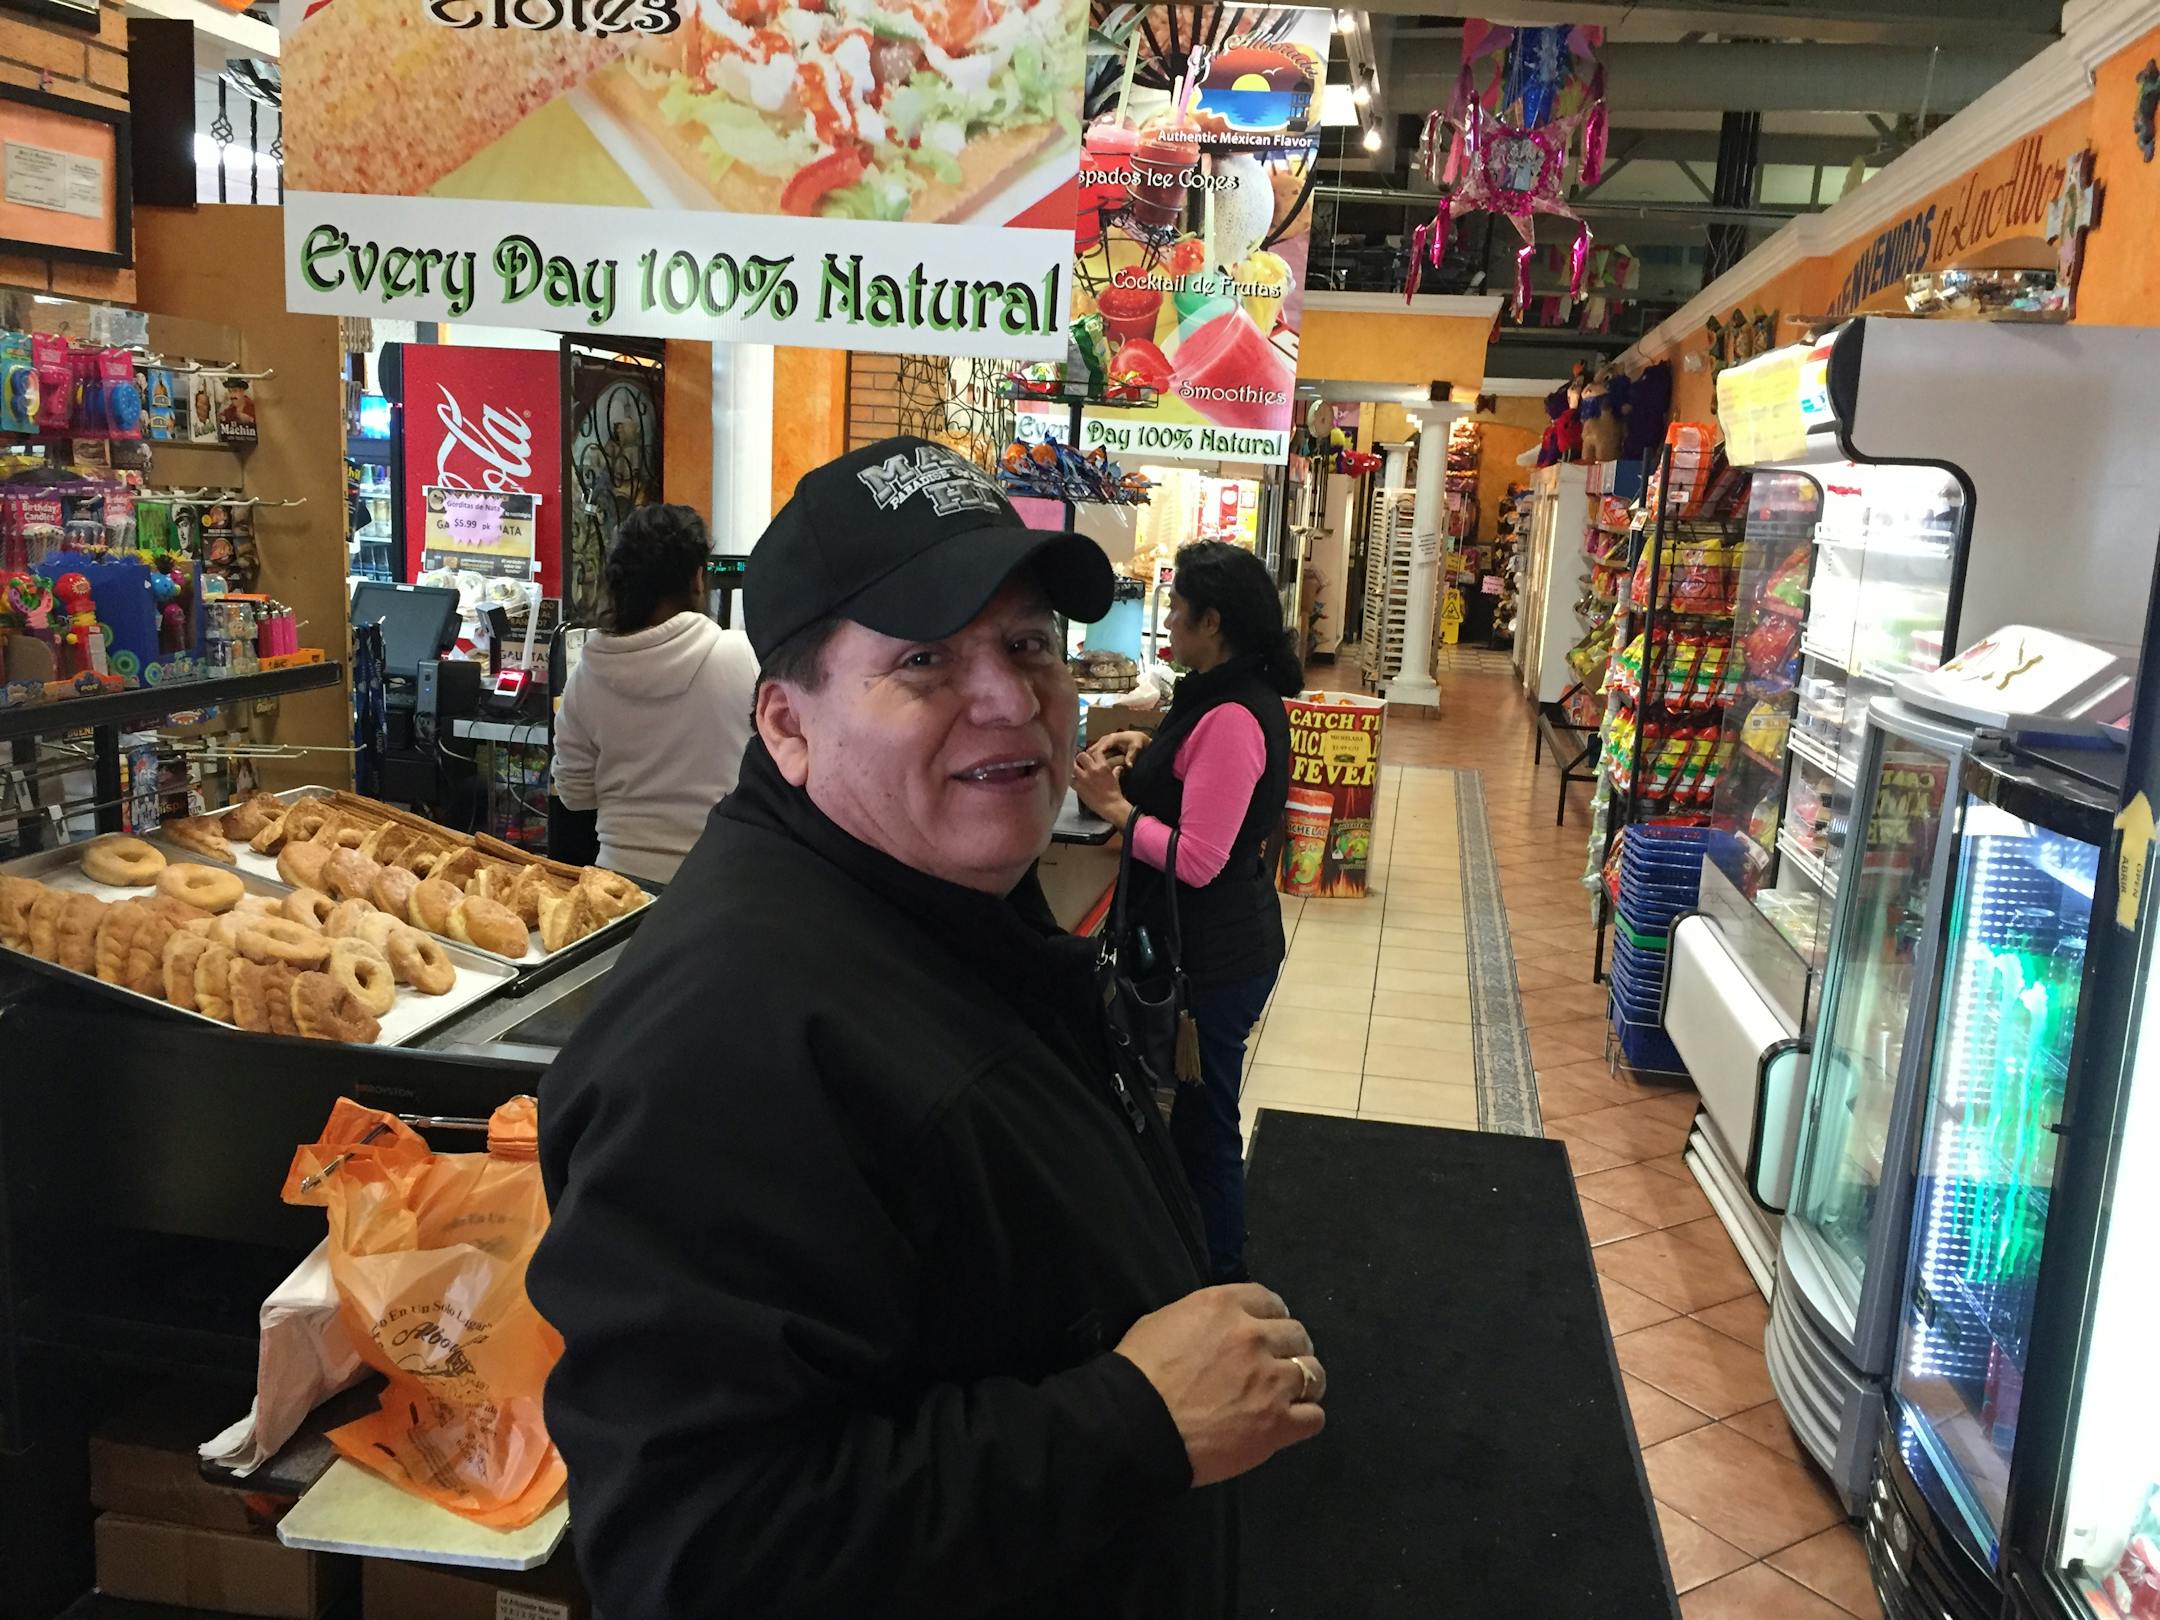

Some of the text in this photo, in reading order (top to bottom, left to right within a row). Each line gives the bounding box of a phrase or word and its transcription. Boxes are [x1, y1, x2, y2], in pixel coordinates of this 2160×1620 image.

[1158, 129, 1218, 143] Authentic
[1273, 134, 1314, 148] Flavor
[1078, 165, 1239, 191] spados Ice Cones
[300, 224, 1061, 338] Every Day 100% Natural
[1112, 269, 1282, 299] Cocktail de Frutas
[1179, 380, 1288, 406] Smoothies
[1018, 415, 1282, 457] Ever Day 100% Natural
[890, 468, 951, 511] PARADISE
[21, 500, 57, 514] Birthday
[23, 512, 55, 522] Candles
[446, 501, 474, 511] Gorditas
[475, 503, 484, 511] de
[454, 518, 491, 531] $5.99 pk
[1289, 708, 1356, 730] CATCH
[389, 1307, 408, 1322] En
[431, 1300, 456, 1317] Solo
